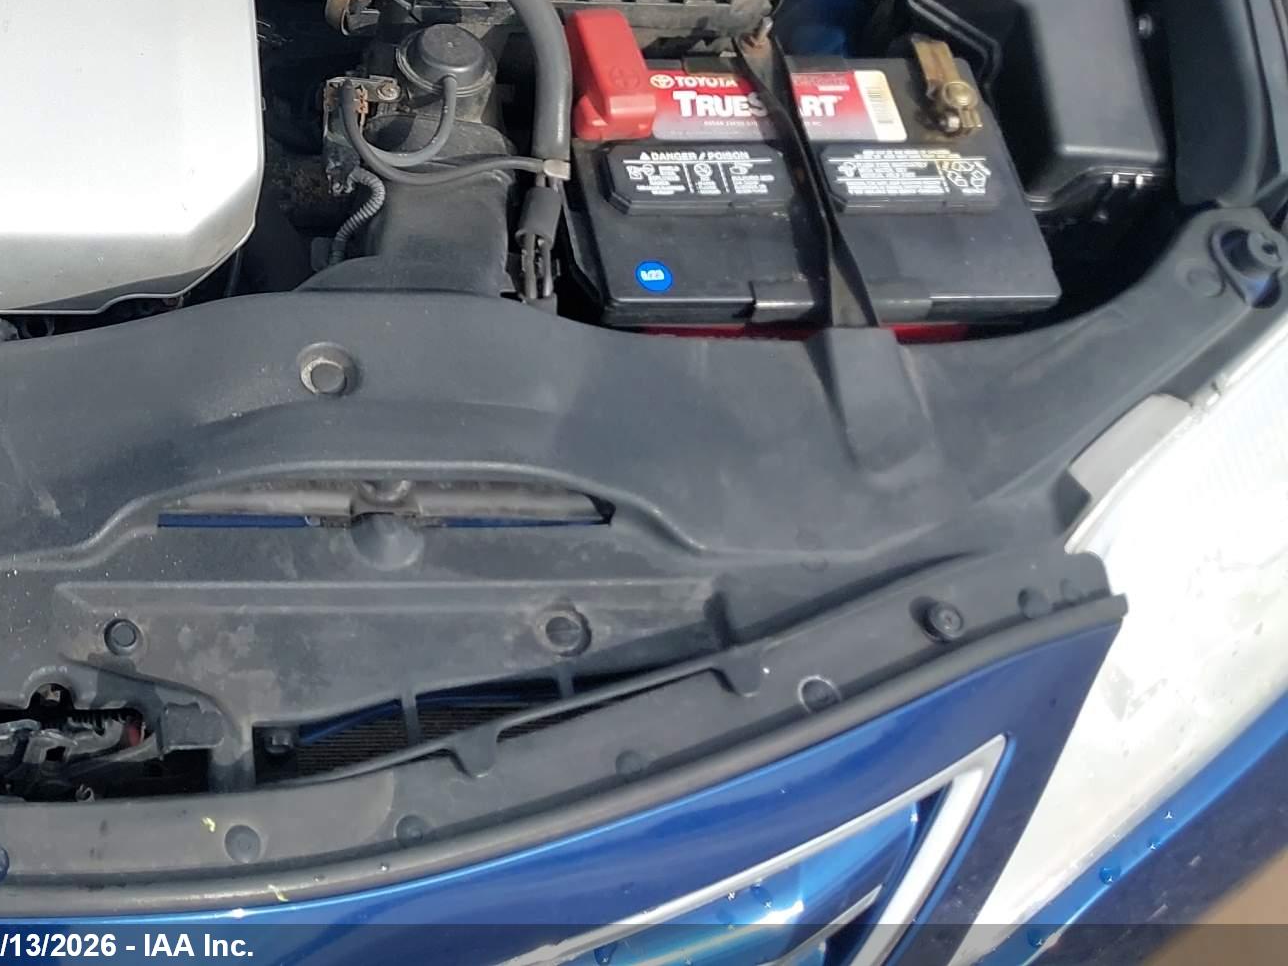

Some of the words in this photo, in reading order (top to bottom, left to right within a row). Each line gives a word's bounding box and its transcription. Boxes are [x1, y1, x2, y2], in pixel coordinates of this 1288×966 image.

[674, 75, 738, 88] TOYOTA
[650, 151, 698, 160] DANGER
[707, 151, 750, 160] POISON
